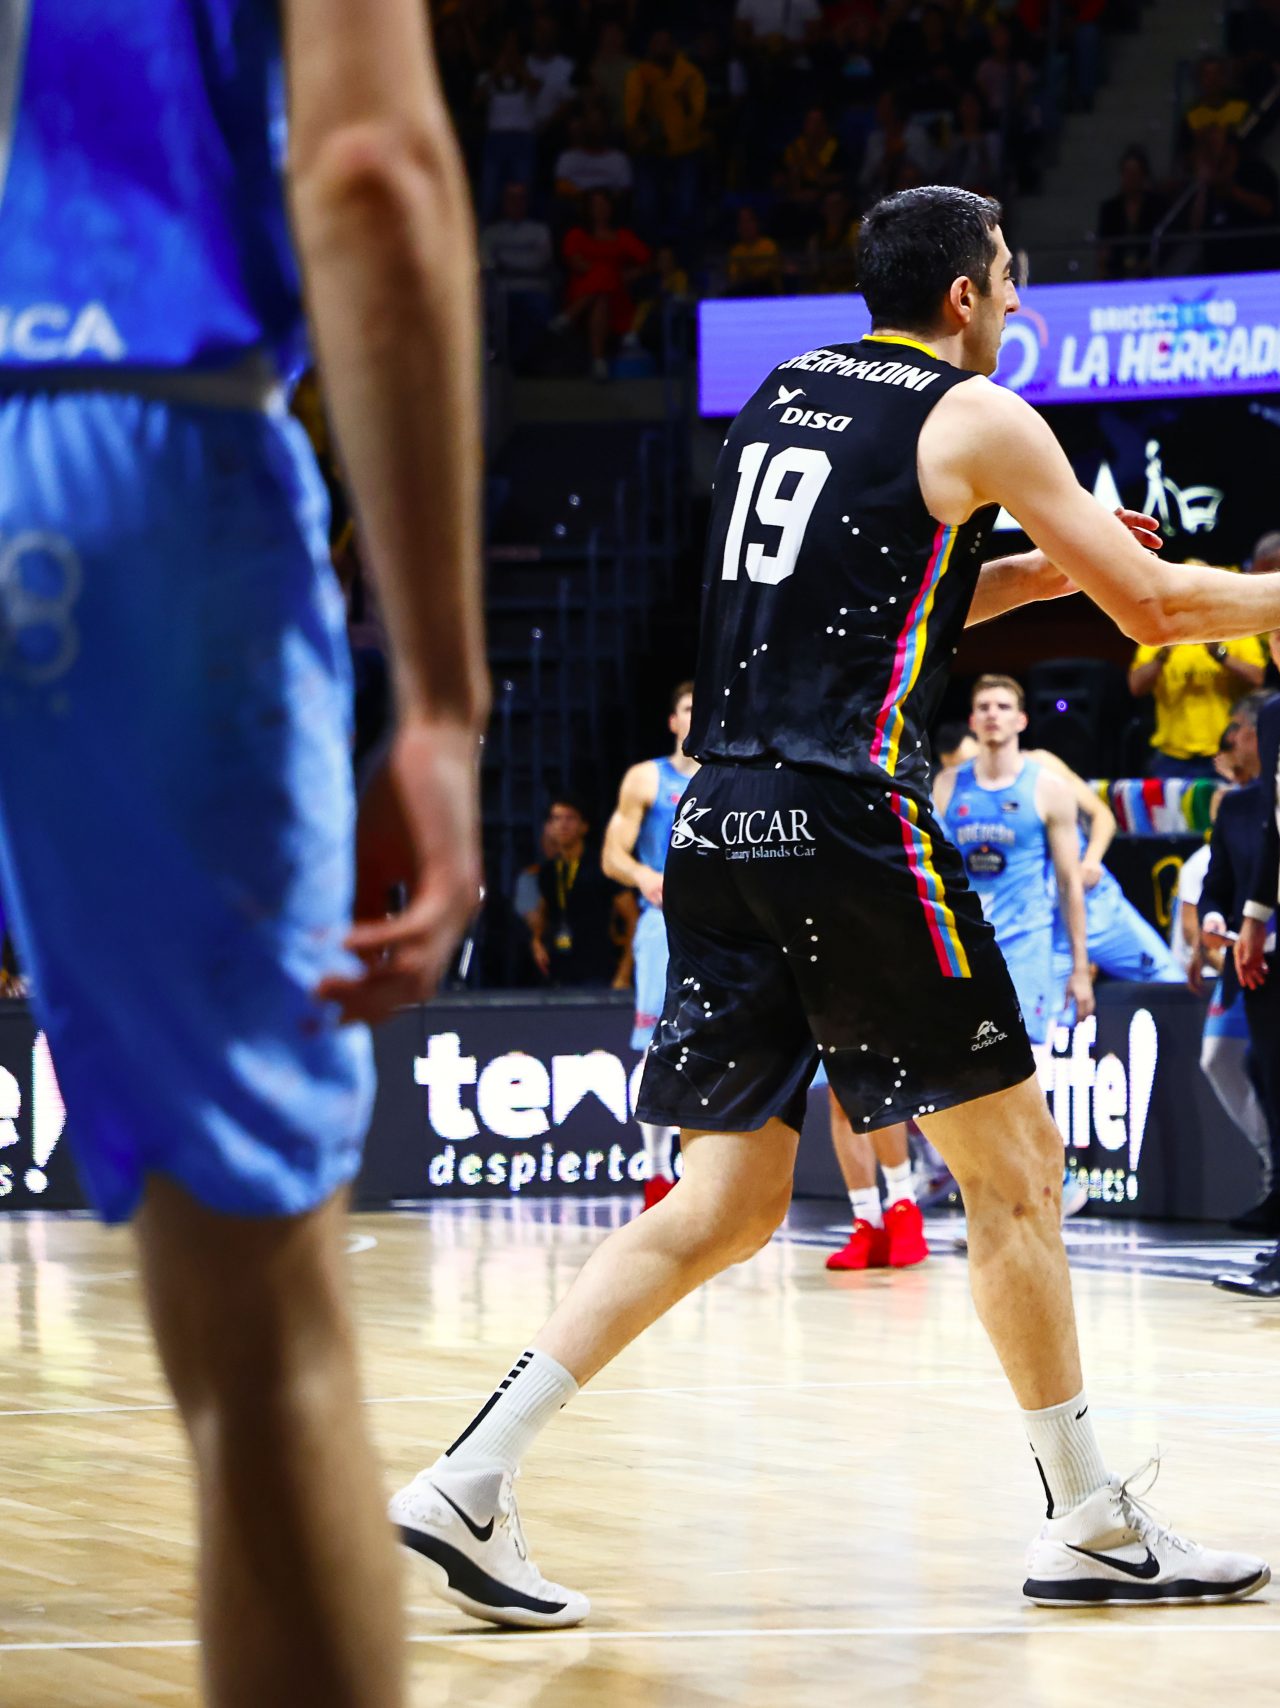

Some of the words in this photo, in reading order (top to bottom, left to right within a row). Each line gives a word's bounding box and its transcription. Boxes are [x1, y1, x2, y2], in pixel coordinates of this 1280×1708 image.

[1057, 335, 1111, 388] LA
[721, 441, 833, 586] 19
[721, 809, 816, 846] CICAR
[752, 845, 790, 859] Islands
[793, 845, 817, 857] Car
